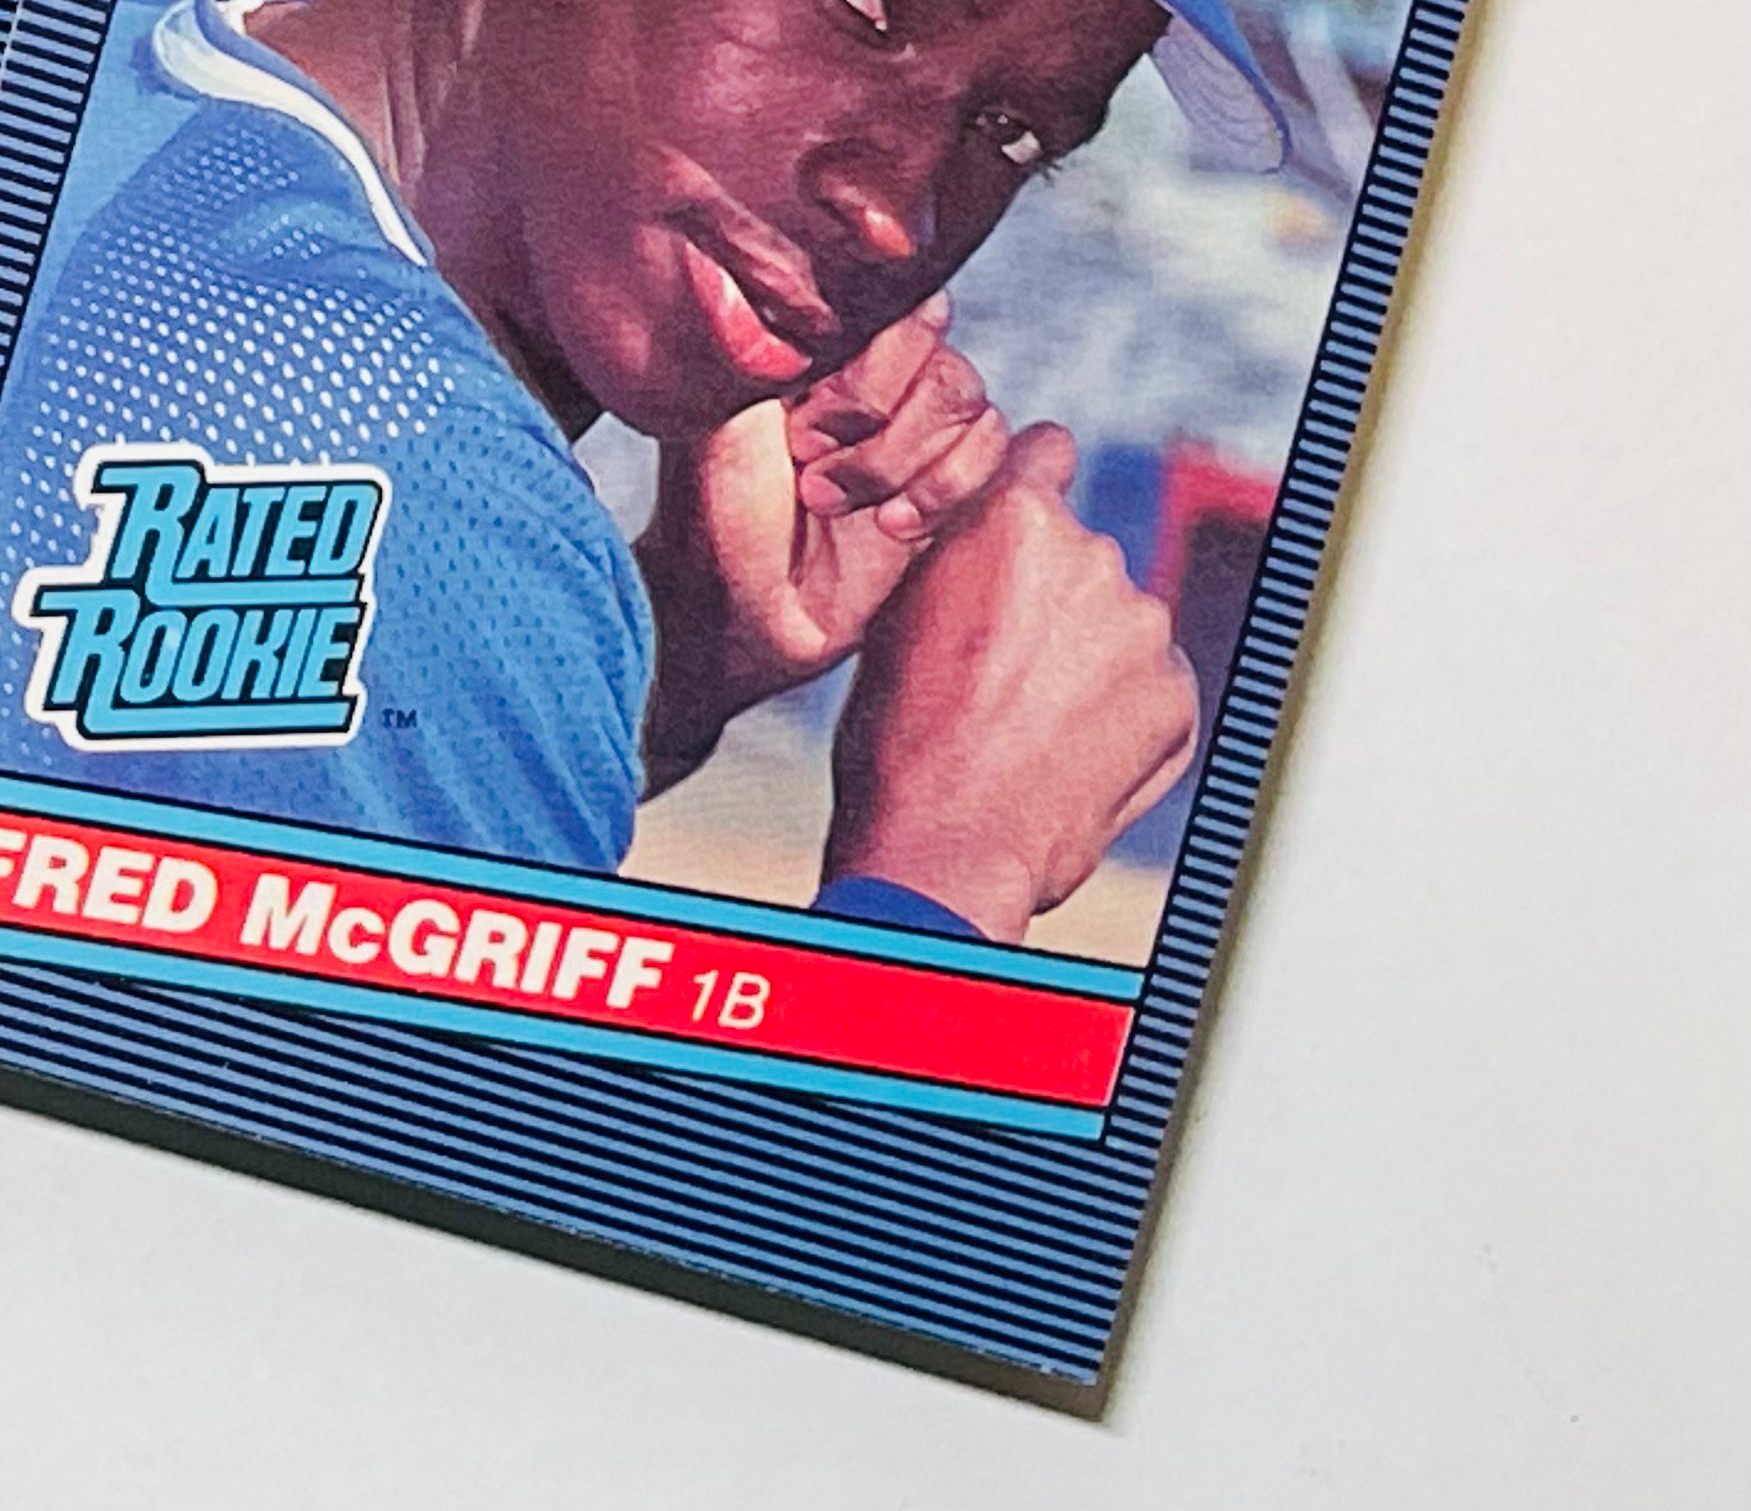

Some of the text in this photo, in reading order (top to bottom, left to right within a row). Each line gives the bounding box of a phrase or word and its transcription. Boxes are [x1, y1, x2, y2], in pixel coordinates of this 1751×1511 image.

[93, 460, 382, 606] RATED
[31, 586, 365, 735] ROOKIE
[382, 708, 417, 728] TM
[241, 872, 674, 1010] McGRIFF
[690, 968, 772, 1029] 1B
